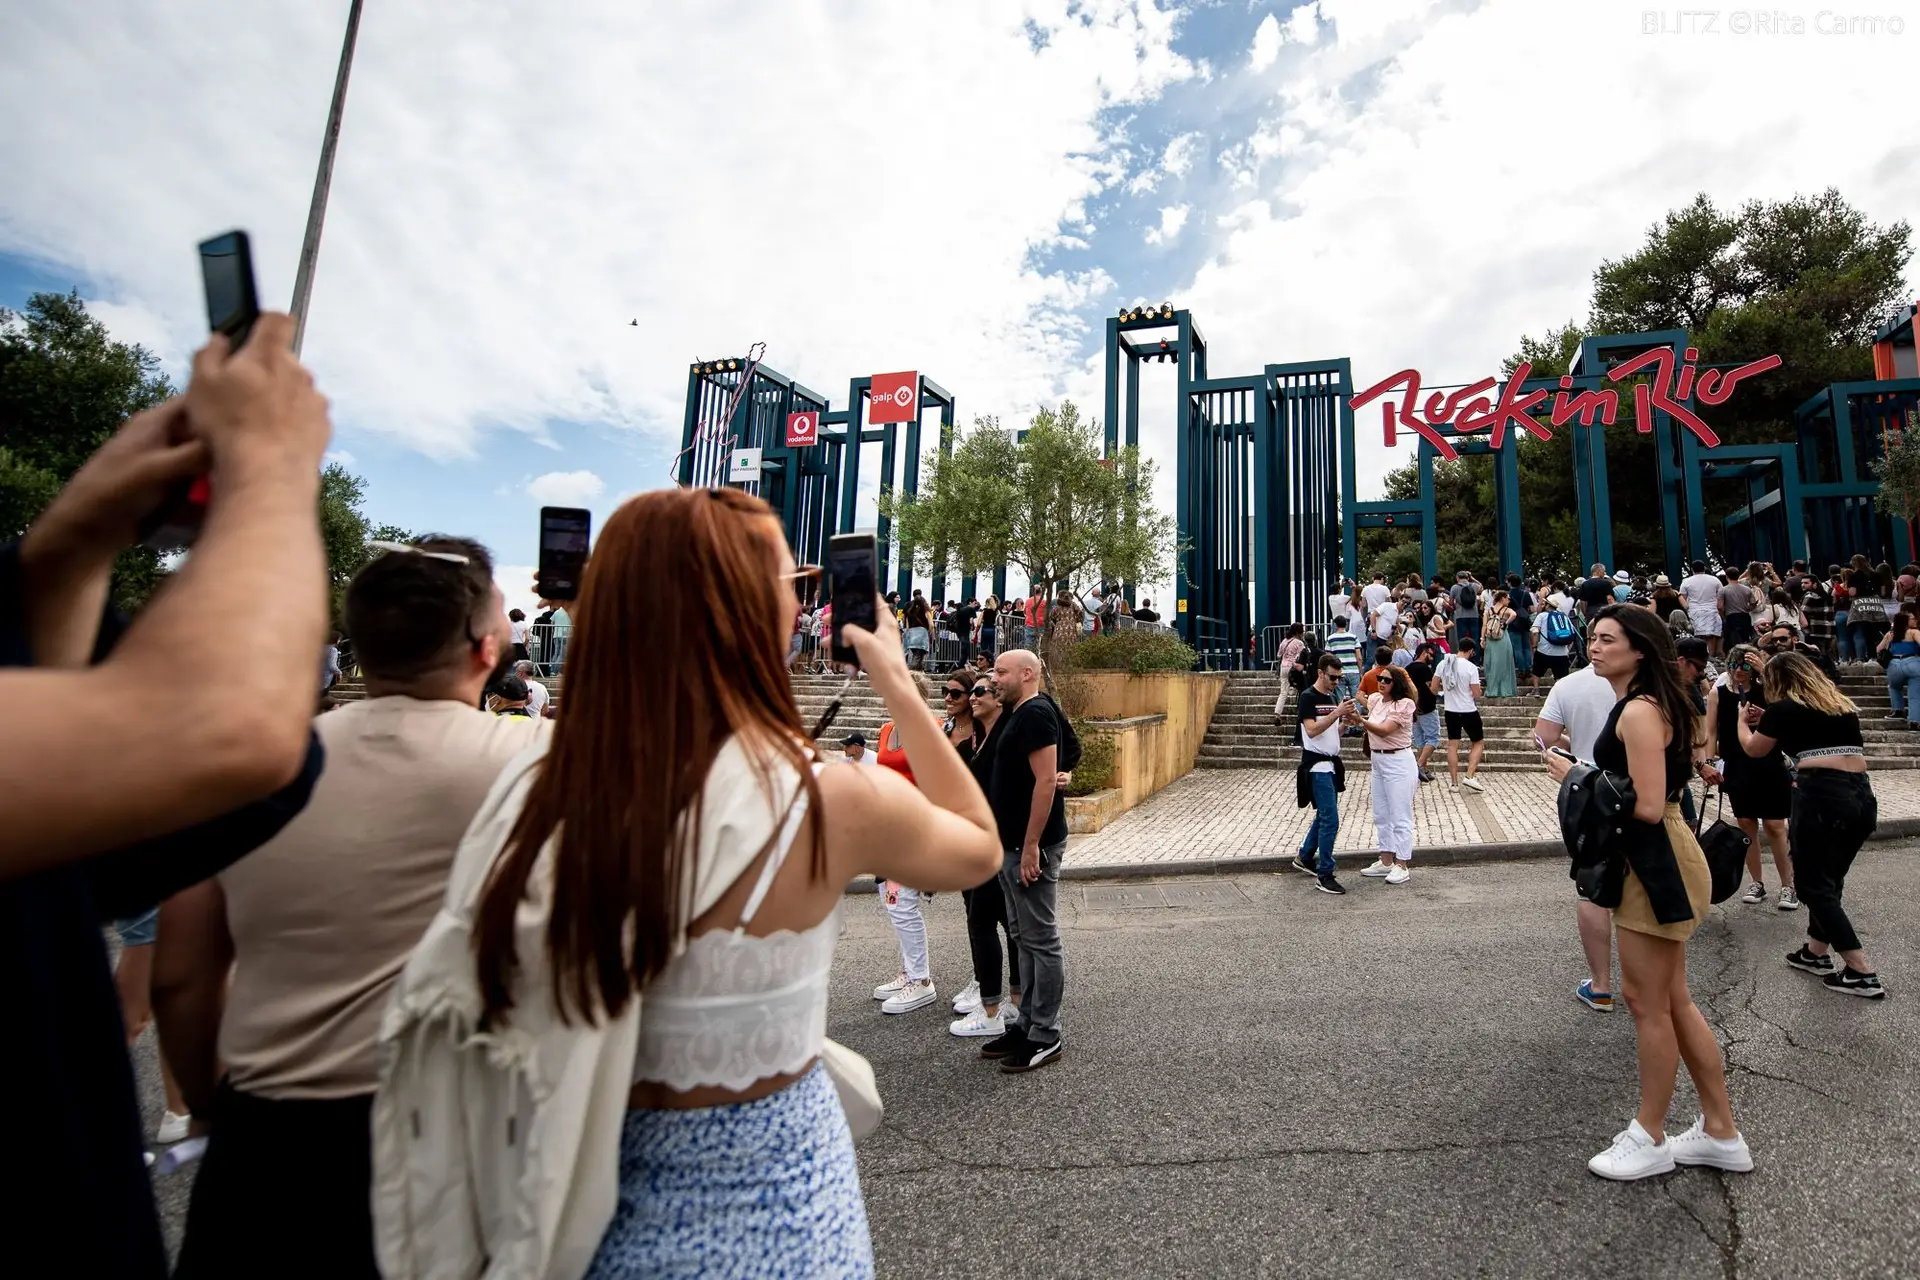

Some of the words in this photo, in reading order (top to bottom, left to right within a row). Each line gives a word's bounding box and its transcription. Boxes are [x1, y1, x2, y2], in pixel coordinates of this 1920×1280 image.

[872, 392, 893, 404] galp
[1348, 361, 1553, 462] Rock
[1550, 375, 1619, 427] in
[1608, 346, 1783, 449] Rio
[787, 435, 814, 443] vodafone
